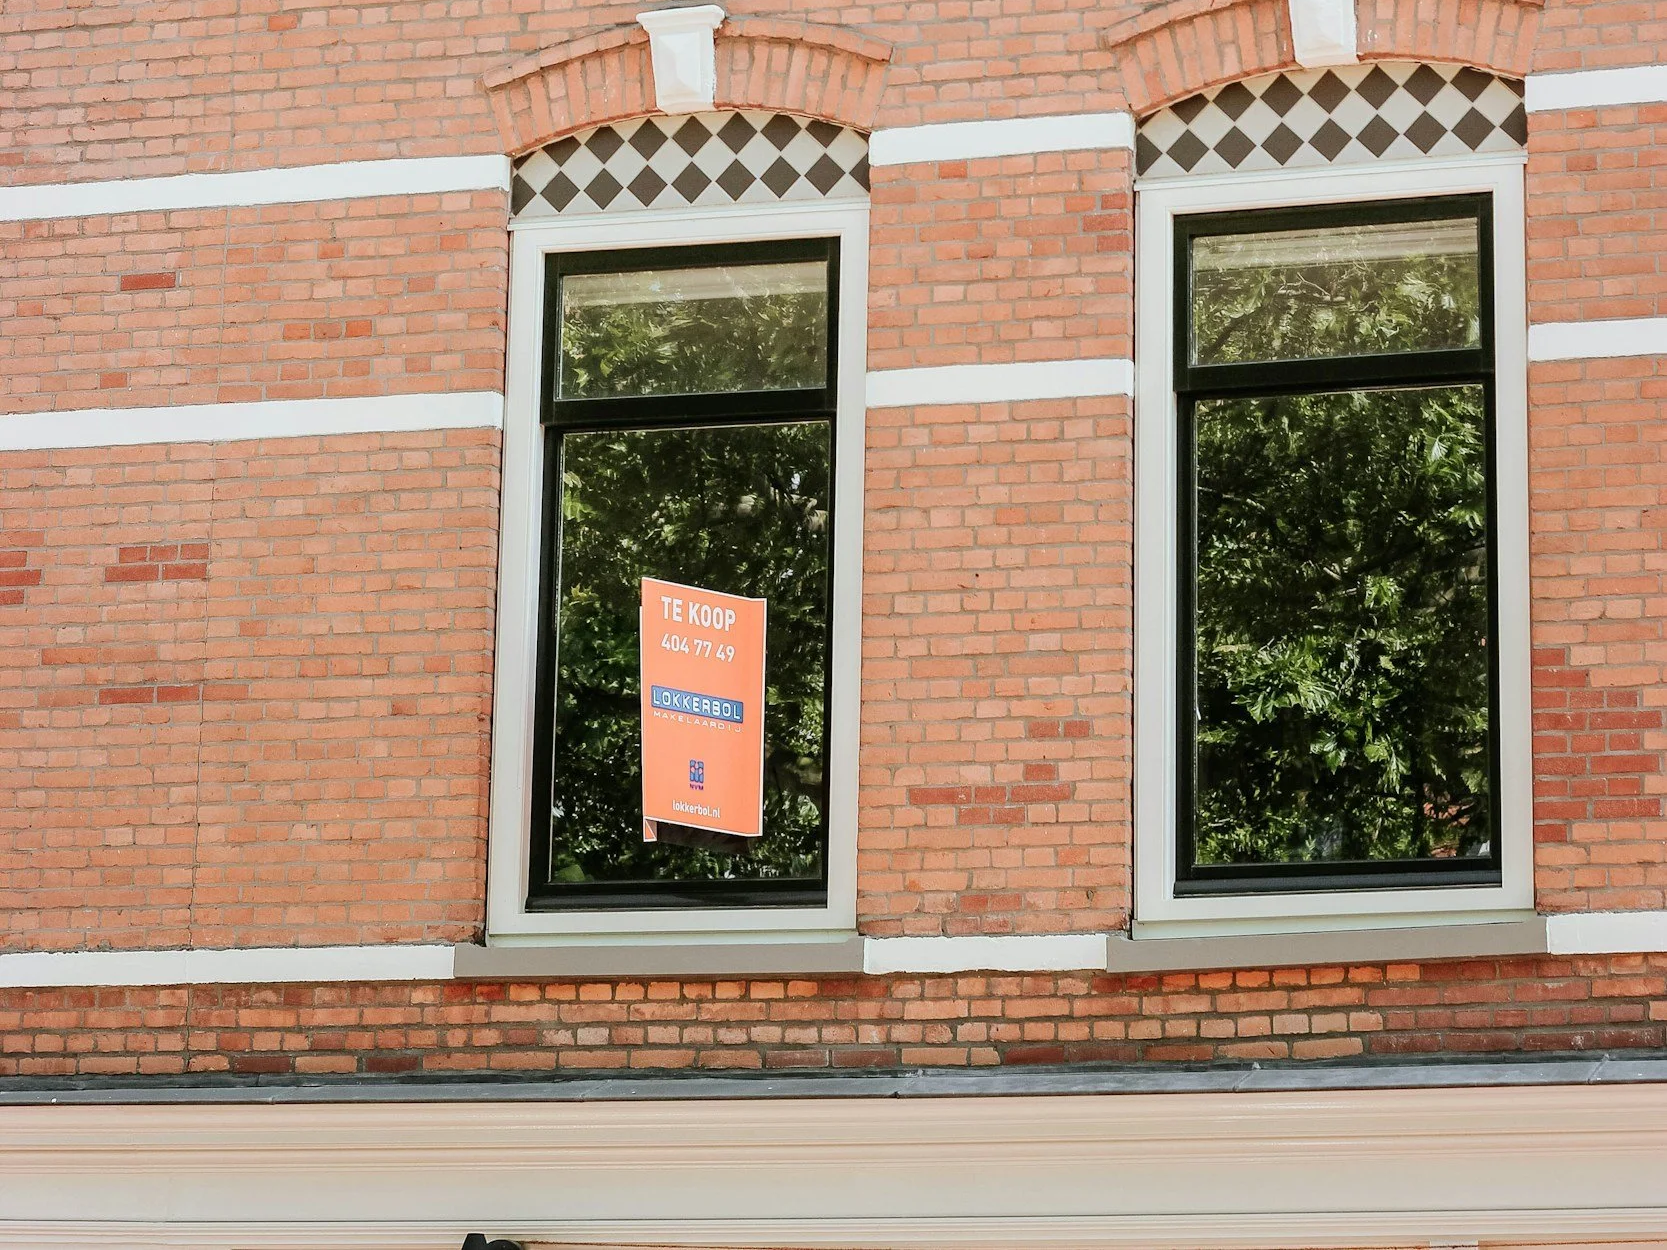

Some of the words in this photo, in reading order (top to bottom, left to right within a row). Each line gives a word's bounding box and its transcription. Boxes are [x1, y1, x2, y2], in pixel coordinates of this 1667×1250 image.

[660, 595, 683, 622] TE
[688, 601, 736, 632] KOOP
[661, 633, 689, 654] 404
[693, 638, 712, 658] 77
[716, 644, 735, 663] 49
[653, 689, 741, 720] LOKKERBOL
[653, 711, 742, 732] MAKELAARDIJ
[672, 799, 721, 818] lokkerbol.nl
